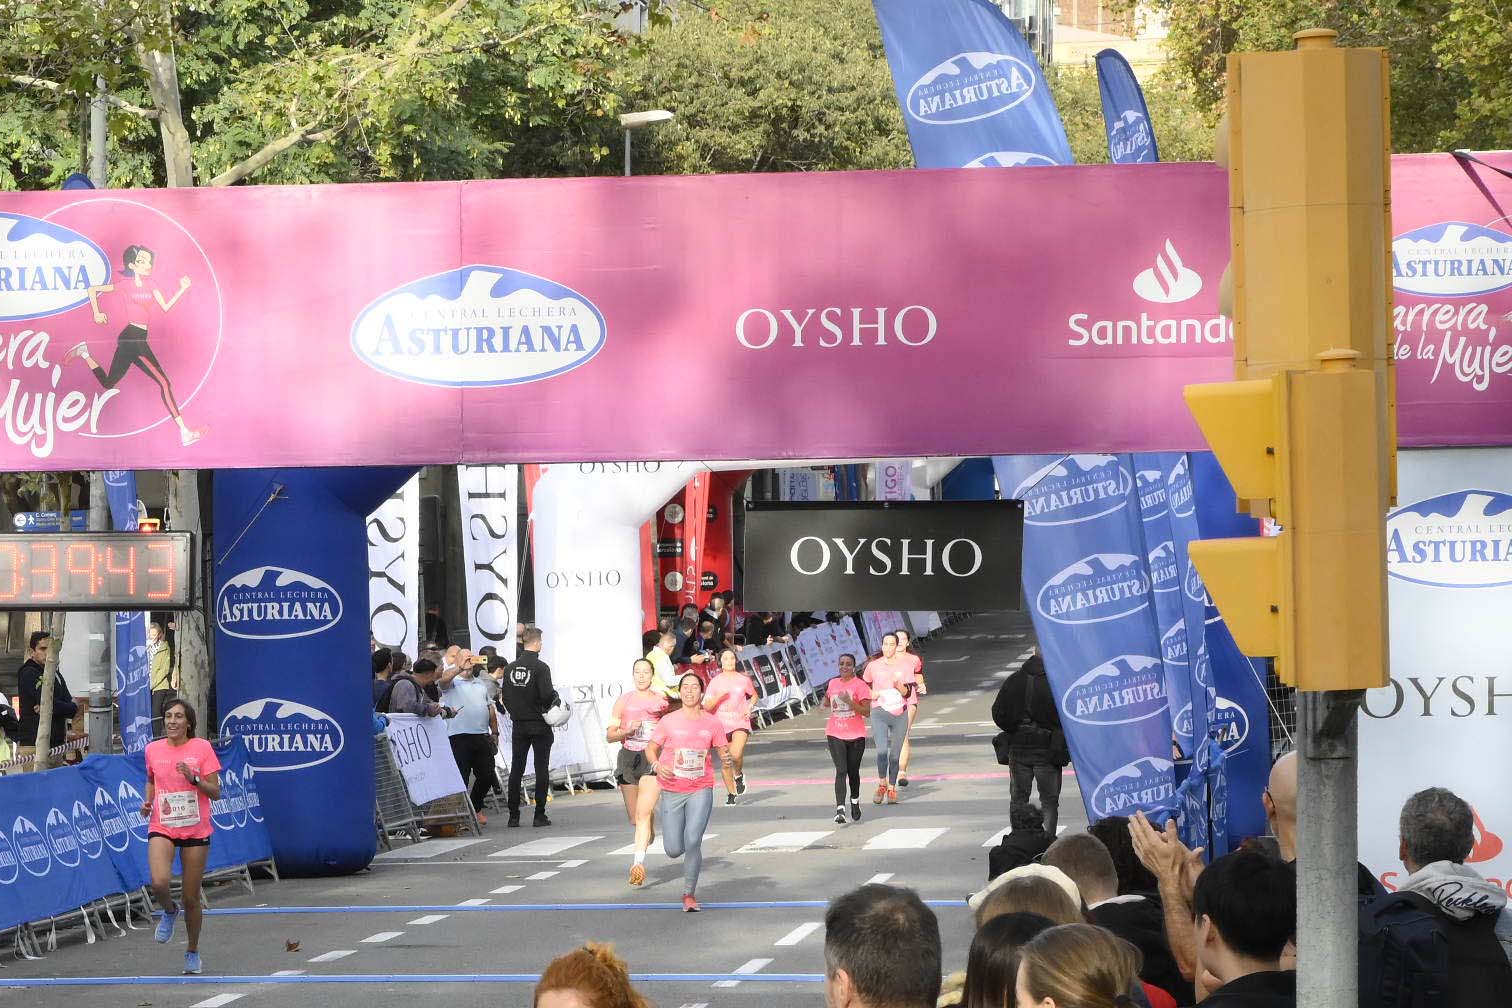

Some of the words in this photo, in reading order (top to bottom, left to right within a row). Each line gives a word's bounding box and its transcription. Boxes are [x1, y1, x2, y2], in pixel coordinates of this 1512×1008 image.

[496, 306, 577, 319] LECHERA
[1393, 303, 1488, 331] arrera
[372, 312, 586, 358] ASTURIANA
[734, 305, 937, 350] OYSHO
[1417, 332, 1435, 360] la
[1415, 524, 1477, 534] CENTRAL
[790, 535, 983, 577] OYSHO
[546, 569, 621, 588] OYSHO
[221, 595, 333, 623] ASTURIANA
[233, 592, 275, 600] CENTRAL
[281, 591, 329, 599] LECHERA
[281, 723, 329, 731] LECHERA
